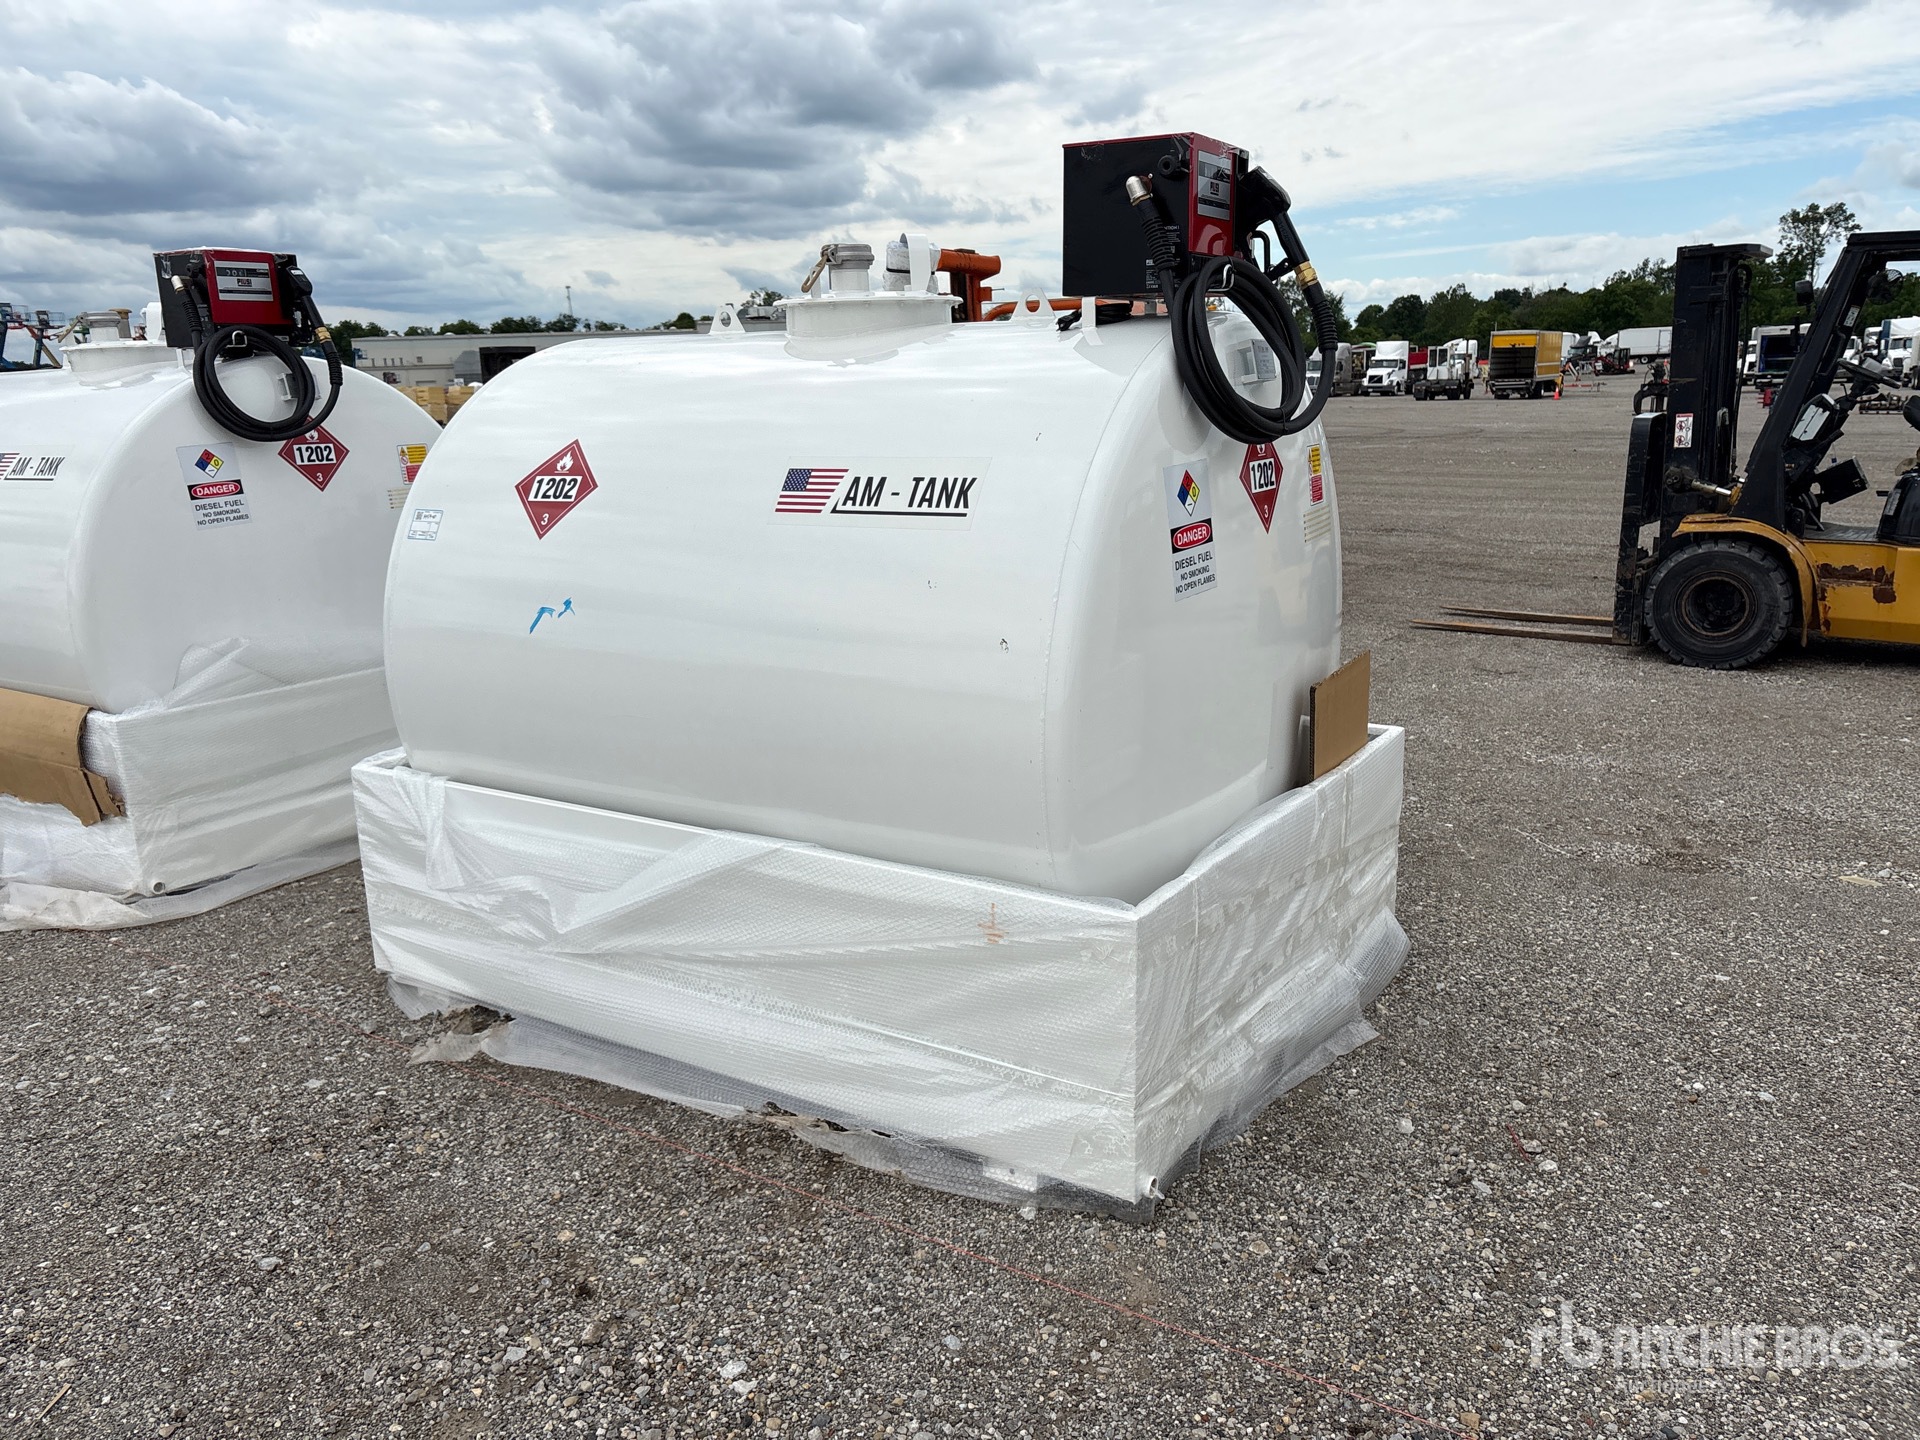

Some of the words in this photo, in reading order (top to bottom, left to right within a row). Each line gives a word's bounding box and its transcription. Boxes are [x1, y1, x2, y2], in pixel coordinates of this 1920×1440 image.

[295, 445, 335, 463] 1202
[9, 457, 32, 476] AM
[33, 457, 65, 476] TANK
[213, 459, 220, 467] 0
[316, 472, 324, 482] 3
[1251, 460, 1275, 490] 1202
[196, 484, 236, 496] DANGER
[533, 477, 578, 500] 1202
[842, 476, 888, 507] AM
[908, 477, 978, 509] TANK
[1191, 486, 1197, 498] 0
[195, 502, 223, 511] DIESEL
[213, 508, 241, 517] SMOKING
[1264, 504, 1269, 518] 3
[208, 517, 225, 525] OPEN
[225, 514, 249, 522] FLAMES
[541, 513, 549, 526] 3
[1177, 526, 1208, 546] DANGER
[1175, 556, 1197, 571] DIESEL
[1197, 551, 1213, 563] FUEL
[1180, 572, 1188, 581] NO
[1188, 565, 1210, 578] SMOKING
[1175, 585, 1183, 594] NO
[1183, 579, 1197, 591] OPEN
[1197, 574, 1215, 586] FLAMES
